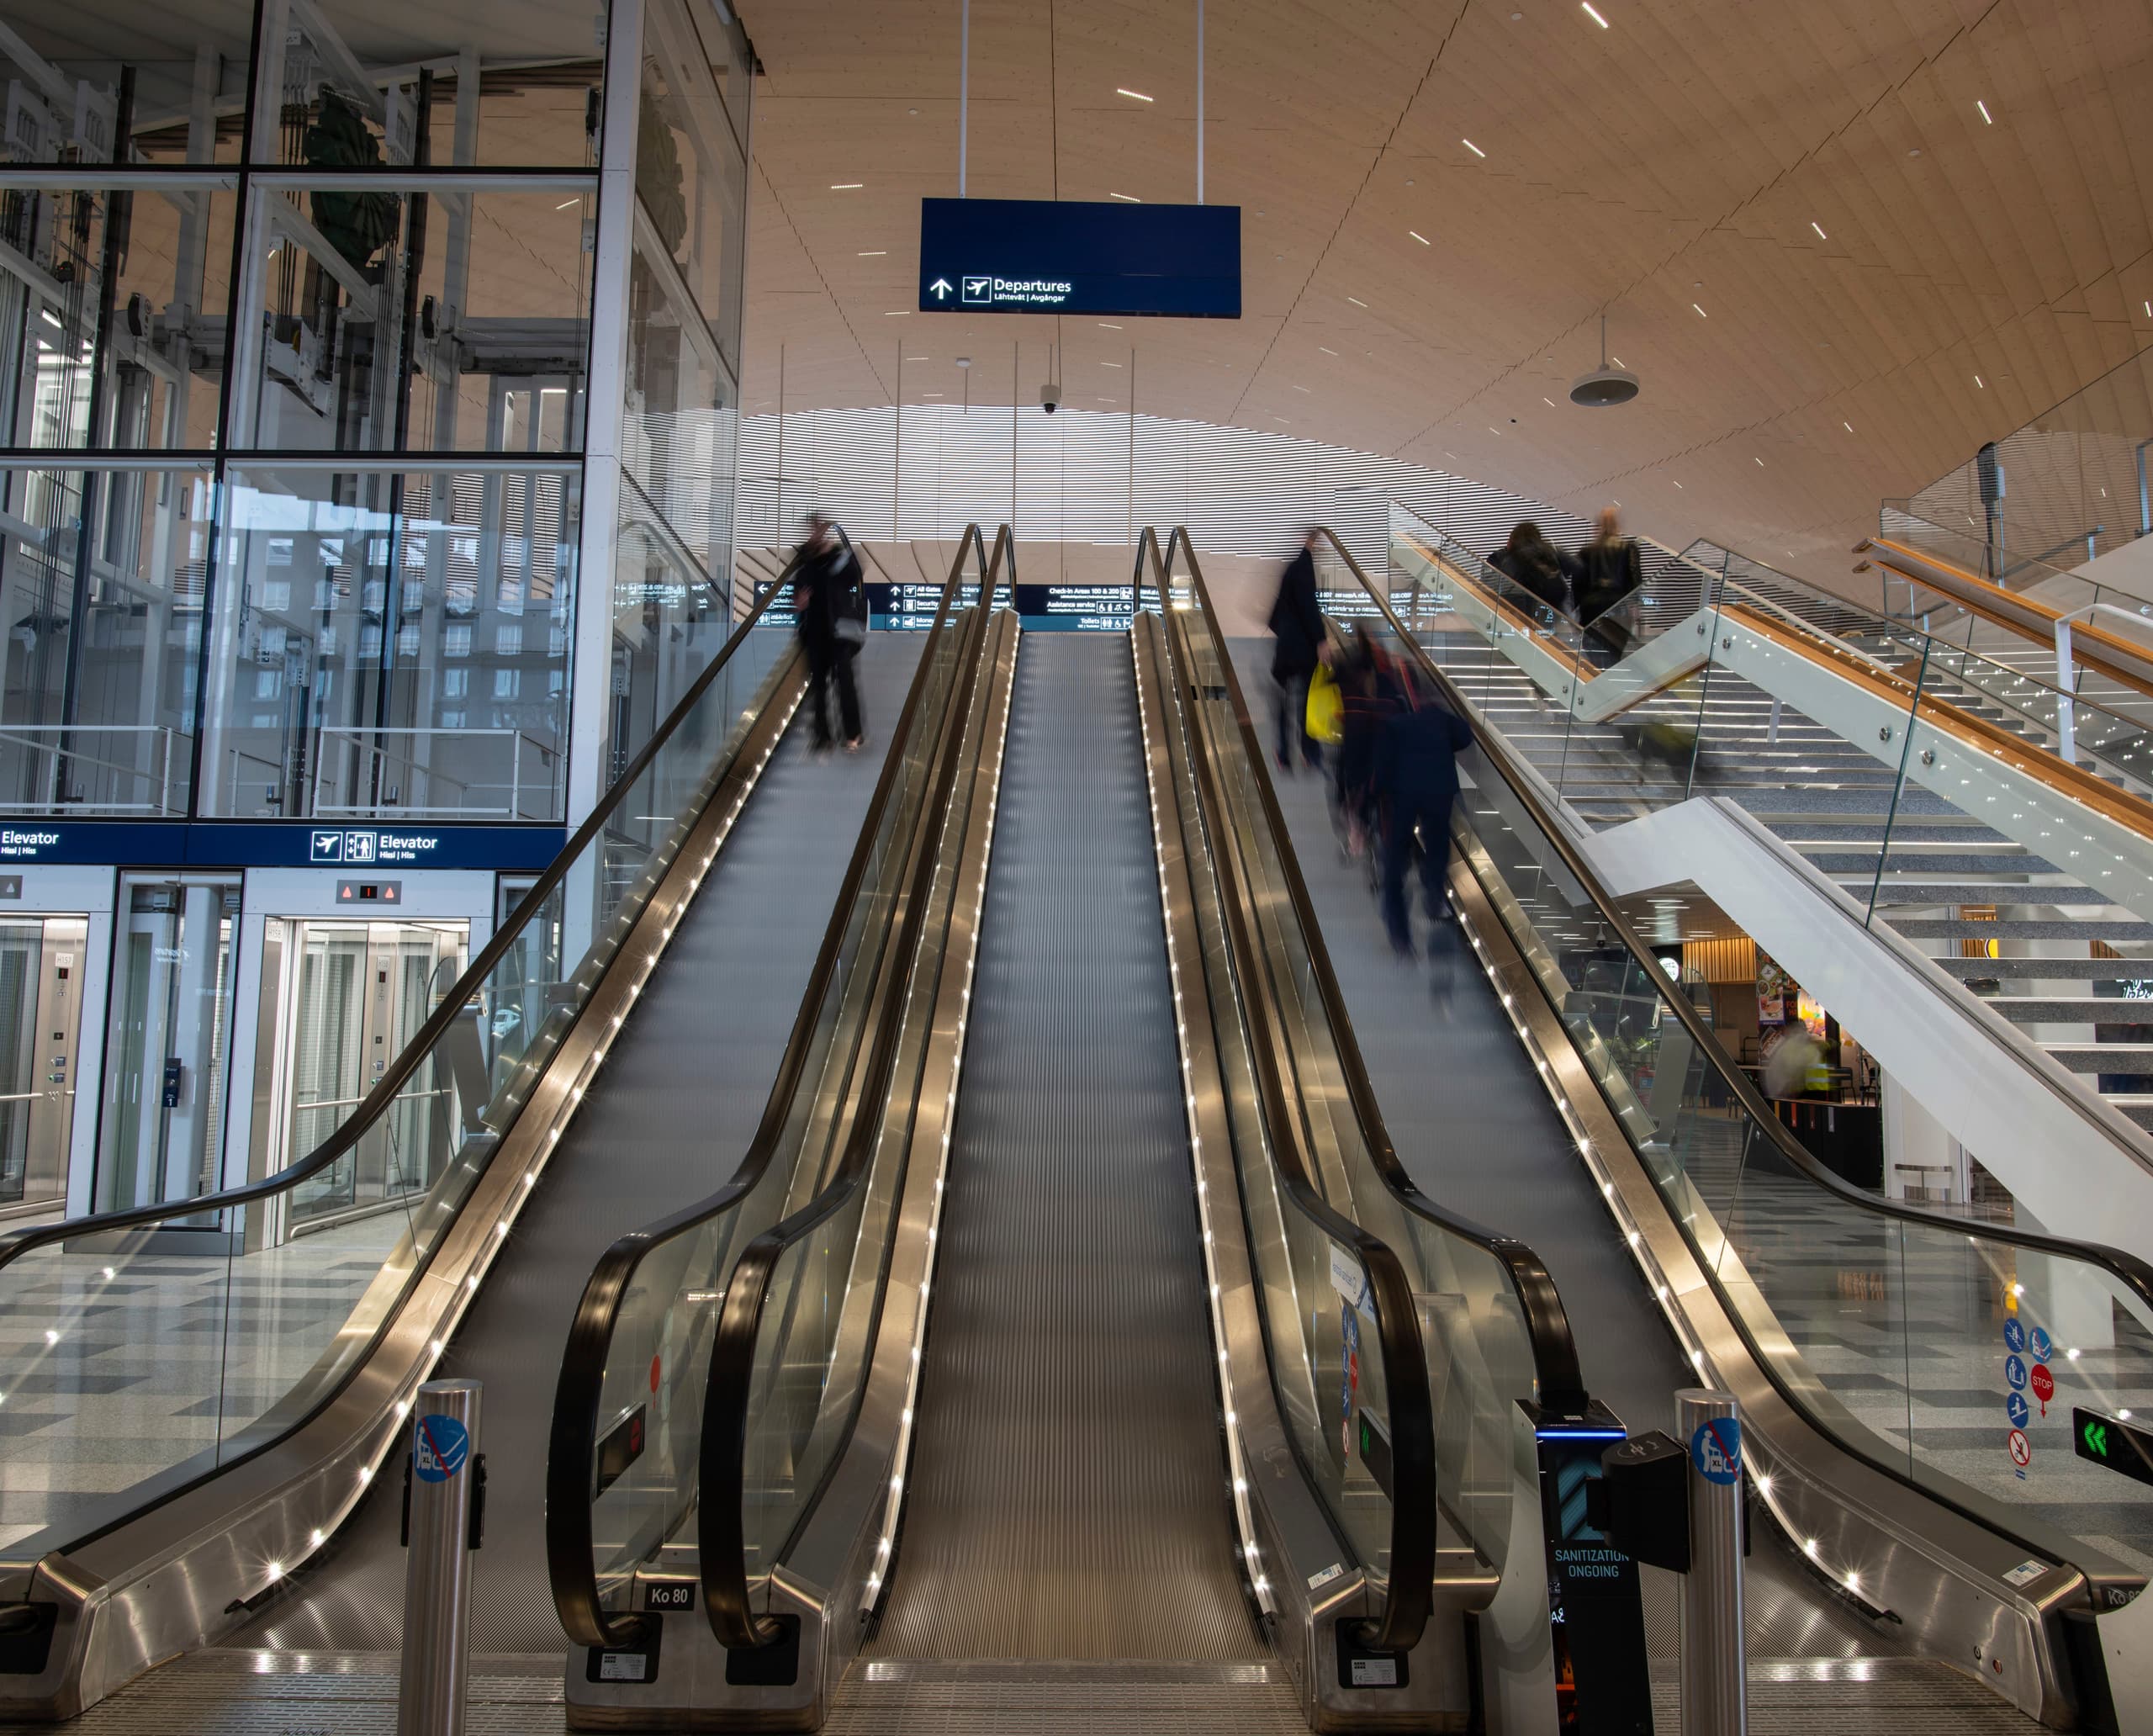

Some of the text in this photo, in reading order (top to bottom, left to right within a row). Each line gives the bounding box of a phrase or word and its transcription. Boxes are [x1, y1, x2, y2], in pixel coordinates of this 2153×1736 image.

[994, 278, 1071, 294] Departures
[1030, 294, 1066, 303] Avgångar
[2, 830, 60, 844] Elevator
[380, 834, 438, 849] Elevator
[1, 846, 17, 855] Hissi
[379, 850, 396, 859] Hissi
[400, 851, 415, 860] Hiss
[2032, 1375, 2052, 1390] STOP
[1568, 1565, 1620, 1578] ONGOING
[652, 1588, 688, 1604] Ko 80
